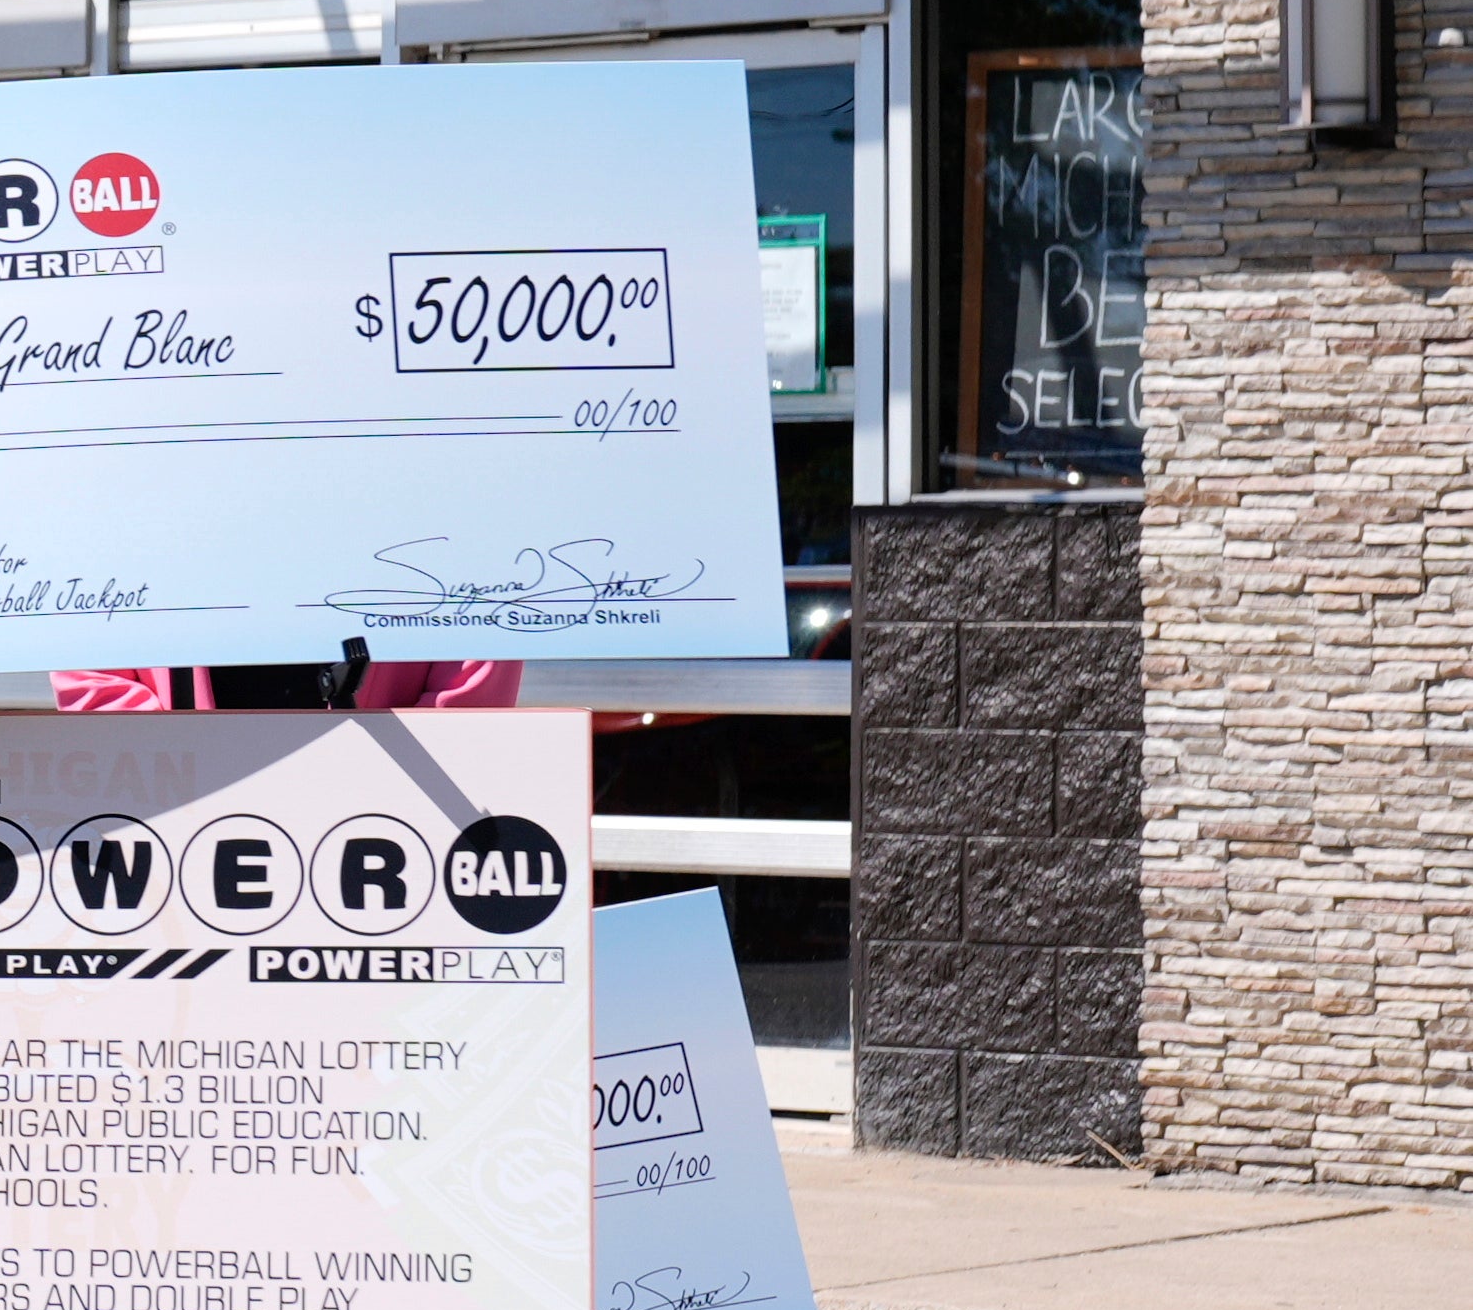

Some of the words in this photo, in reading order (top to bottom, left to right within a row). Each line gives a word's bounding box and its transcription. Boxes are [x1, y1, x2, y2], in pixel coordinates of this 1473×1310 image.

[123, 309, 235, 371] Blanc
[355, 293, 384, 343] $
[572, 388, 683, 443] 00/100
[56, 577, 150, 622] Jackpot
[363, 612, 501, 629] Commissioner
[507, 611, 586, 627] Suzanna
[592, 610, 661, 626] Shkreli
[111, 1071, 184, 1107] $1.3
[199, 1075, 323, 1105] BILLION
[637, 1151, 711, 1195] 00/100
